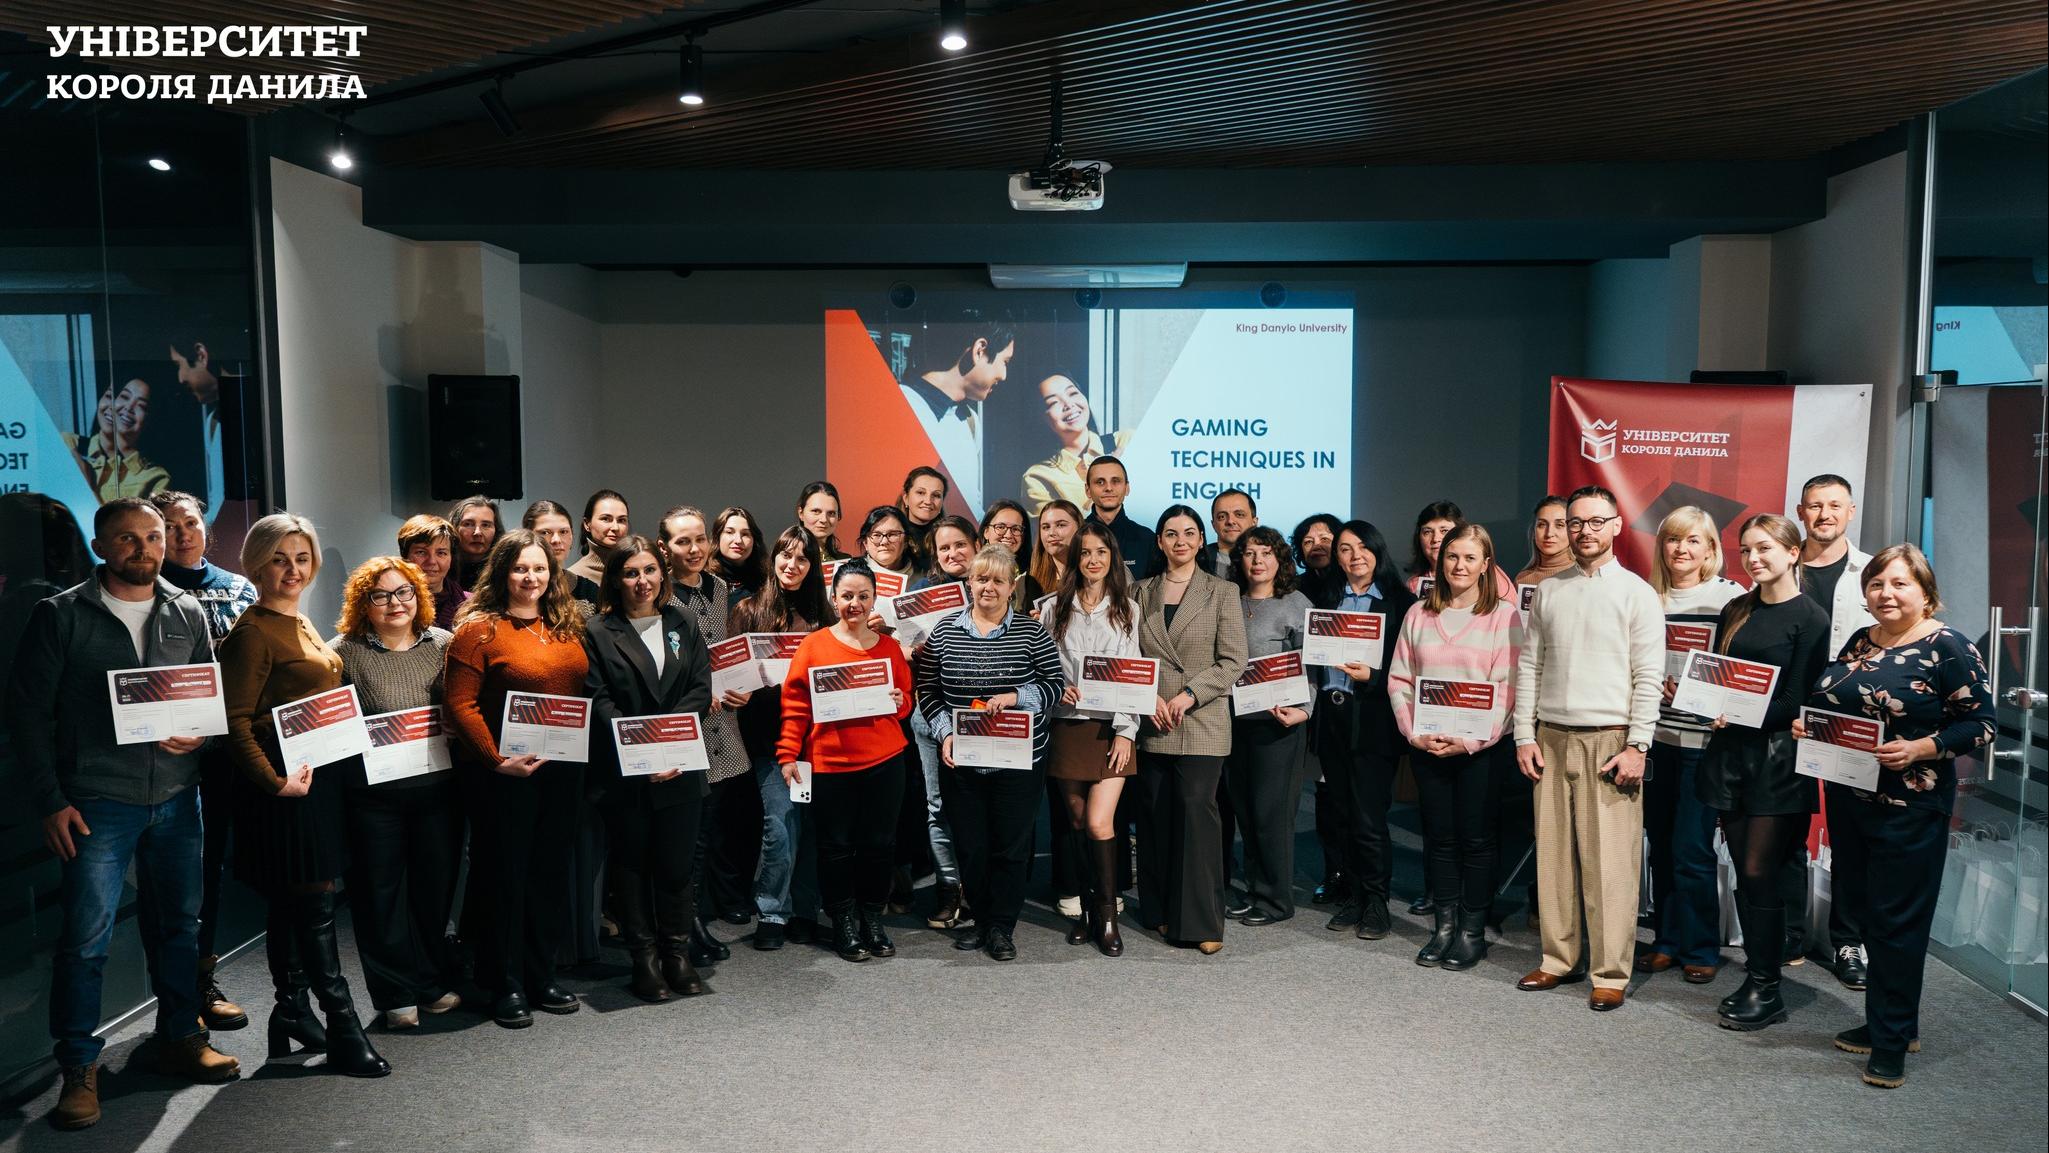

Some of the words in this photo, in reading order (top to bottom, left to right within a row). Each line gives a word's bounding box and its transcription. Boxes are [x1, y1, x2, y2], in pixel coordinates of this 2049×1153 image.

[1236, 323, 1258, 334] King
[1299, 323, 1347, 334] University
[1172, 418, 1268, 436] GAMING
[1623, 429, 1730, 444] УНІВЕРСИТЕТ
[1622, 444, 1671, 455] КОРОЛЯ
[1674, 446, 1729, 457] ДАНИЛА
[1171, 450, 1305, 469] TECHNIQUES
[1314, 451, 1335, 469] IN
